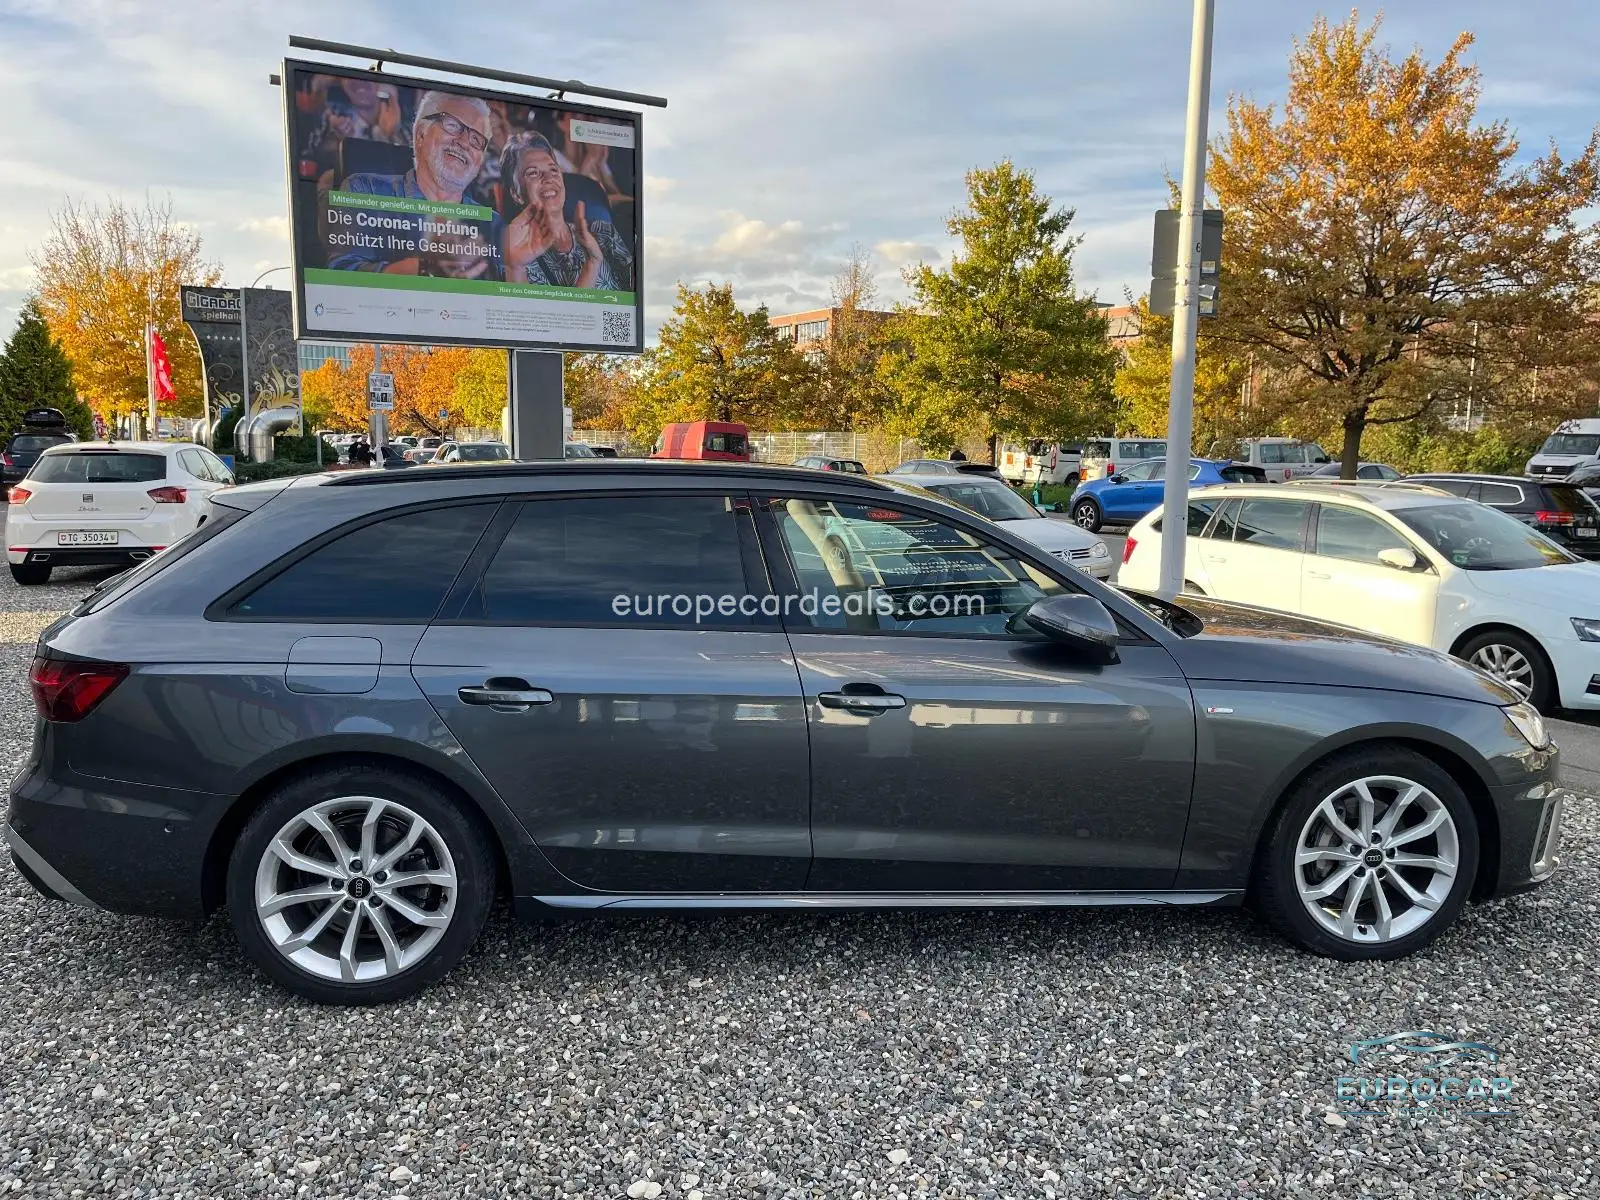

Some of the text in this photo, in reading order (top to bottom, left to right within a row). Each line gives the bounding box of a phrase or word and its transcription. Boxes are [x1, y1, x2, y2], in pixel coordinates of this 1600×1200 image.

[332, 195, 481, 217] Miteinander genießen. Mit gutem Gefühl.
[327, 209, 479, 239] Die Corona-Impfung
[328, 232, 501, 258] schützt Ihre Gesundheit.
[524, 288, 573, 298] Corona-Impfcheck
